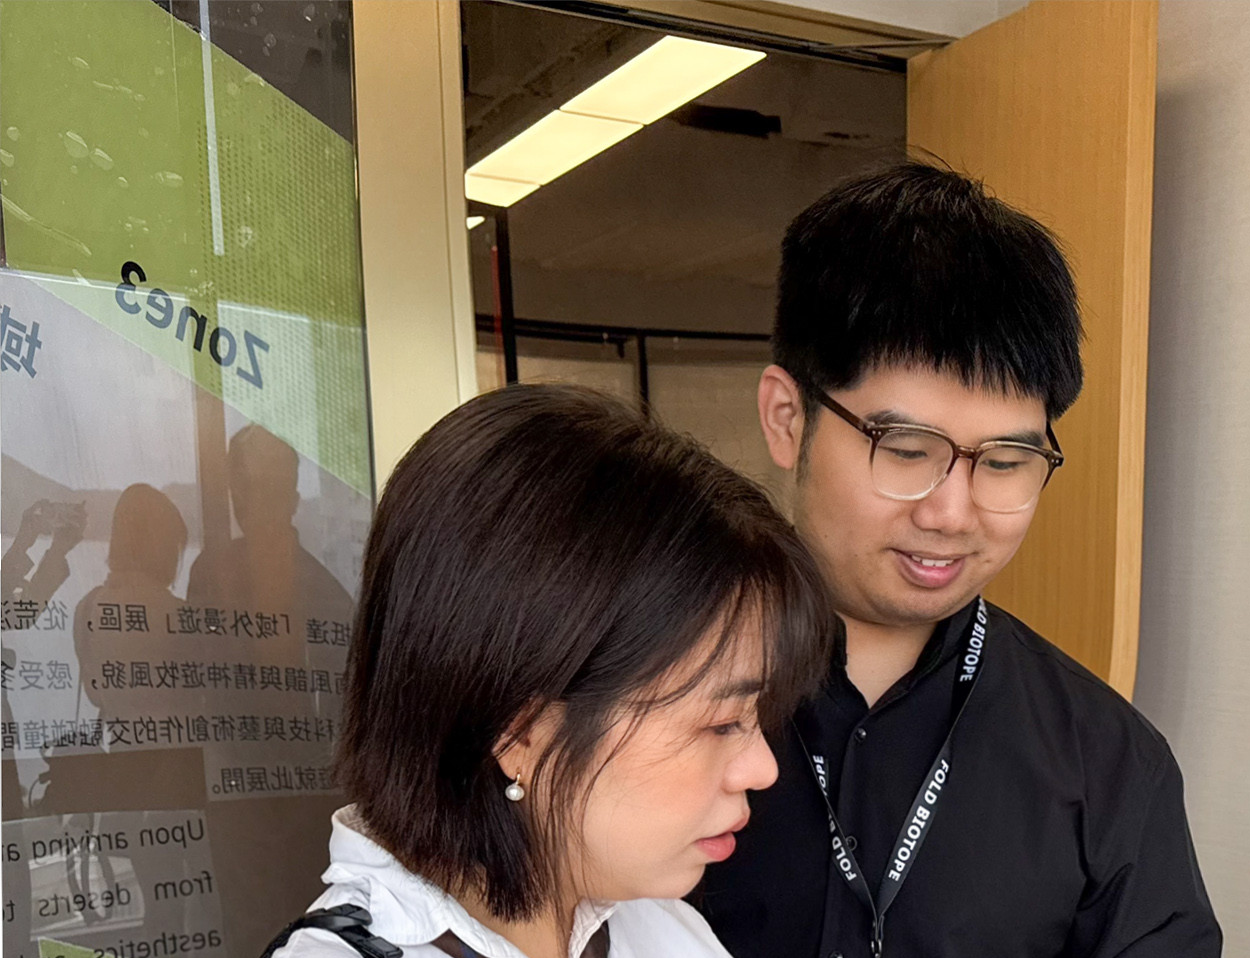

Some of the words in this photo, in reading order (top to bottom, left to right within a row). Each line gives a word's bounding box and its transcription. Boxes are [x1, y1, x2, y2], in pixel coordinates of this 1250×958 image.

[960, 622, 986, 682] BIOTOPE
[923, 759, 950, 805] FOLD
[832, 836, 857, 882] FOLD
[888, 805, 931, 882] BIOTOPE
